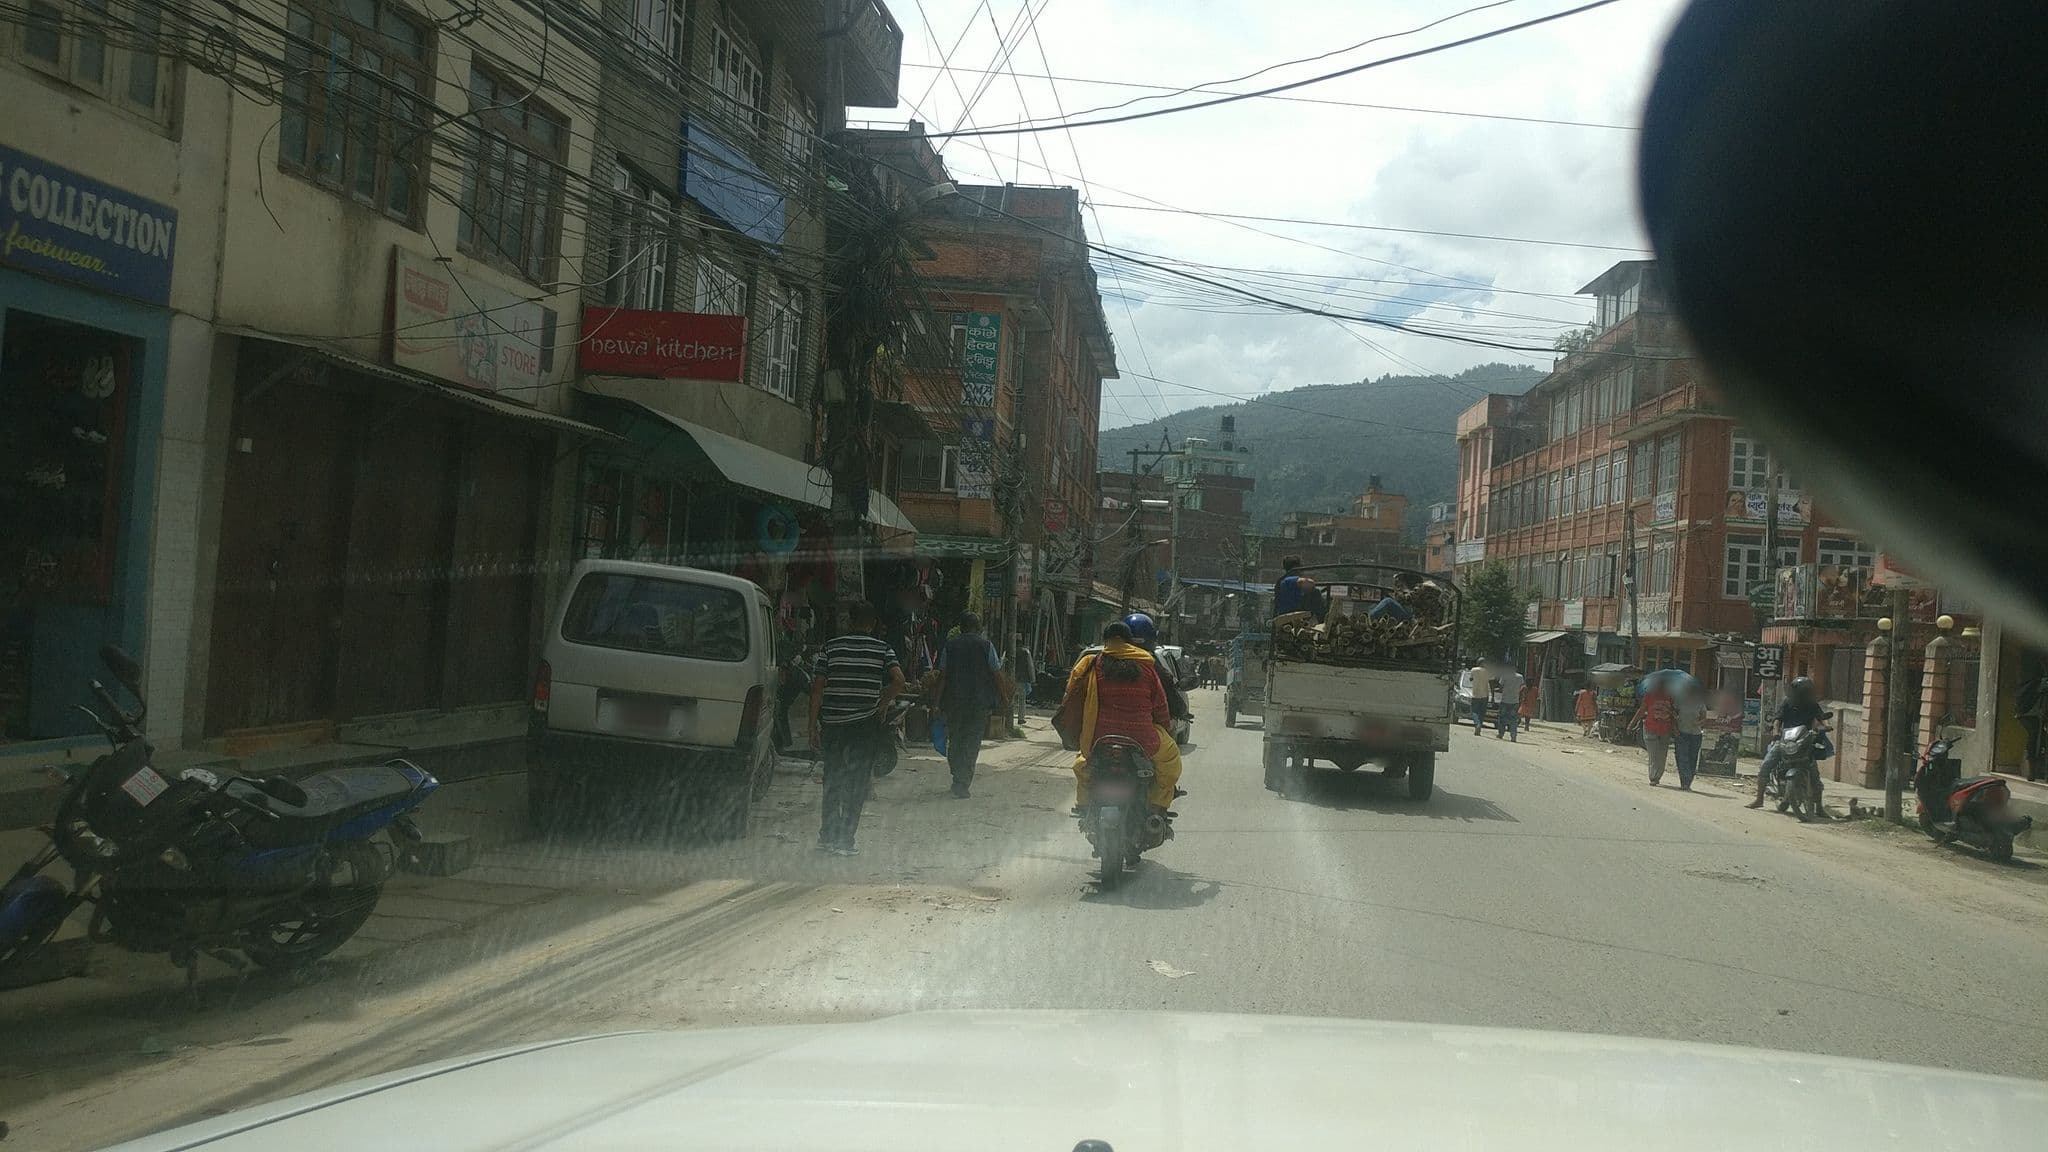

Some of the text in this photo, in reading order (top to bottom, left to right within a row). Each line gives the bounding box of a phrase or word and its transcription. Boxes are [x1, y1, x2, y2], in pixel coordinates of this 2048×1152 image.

[9, 166, 173, 260] COLLECTION
[502, 346, 538, 377] STORE
[591, 337, 739, 361] newa kitchen
